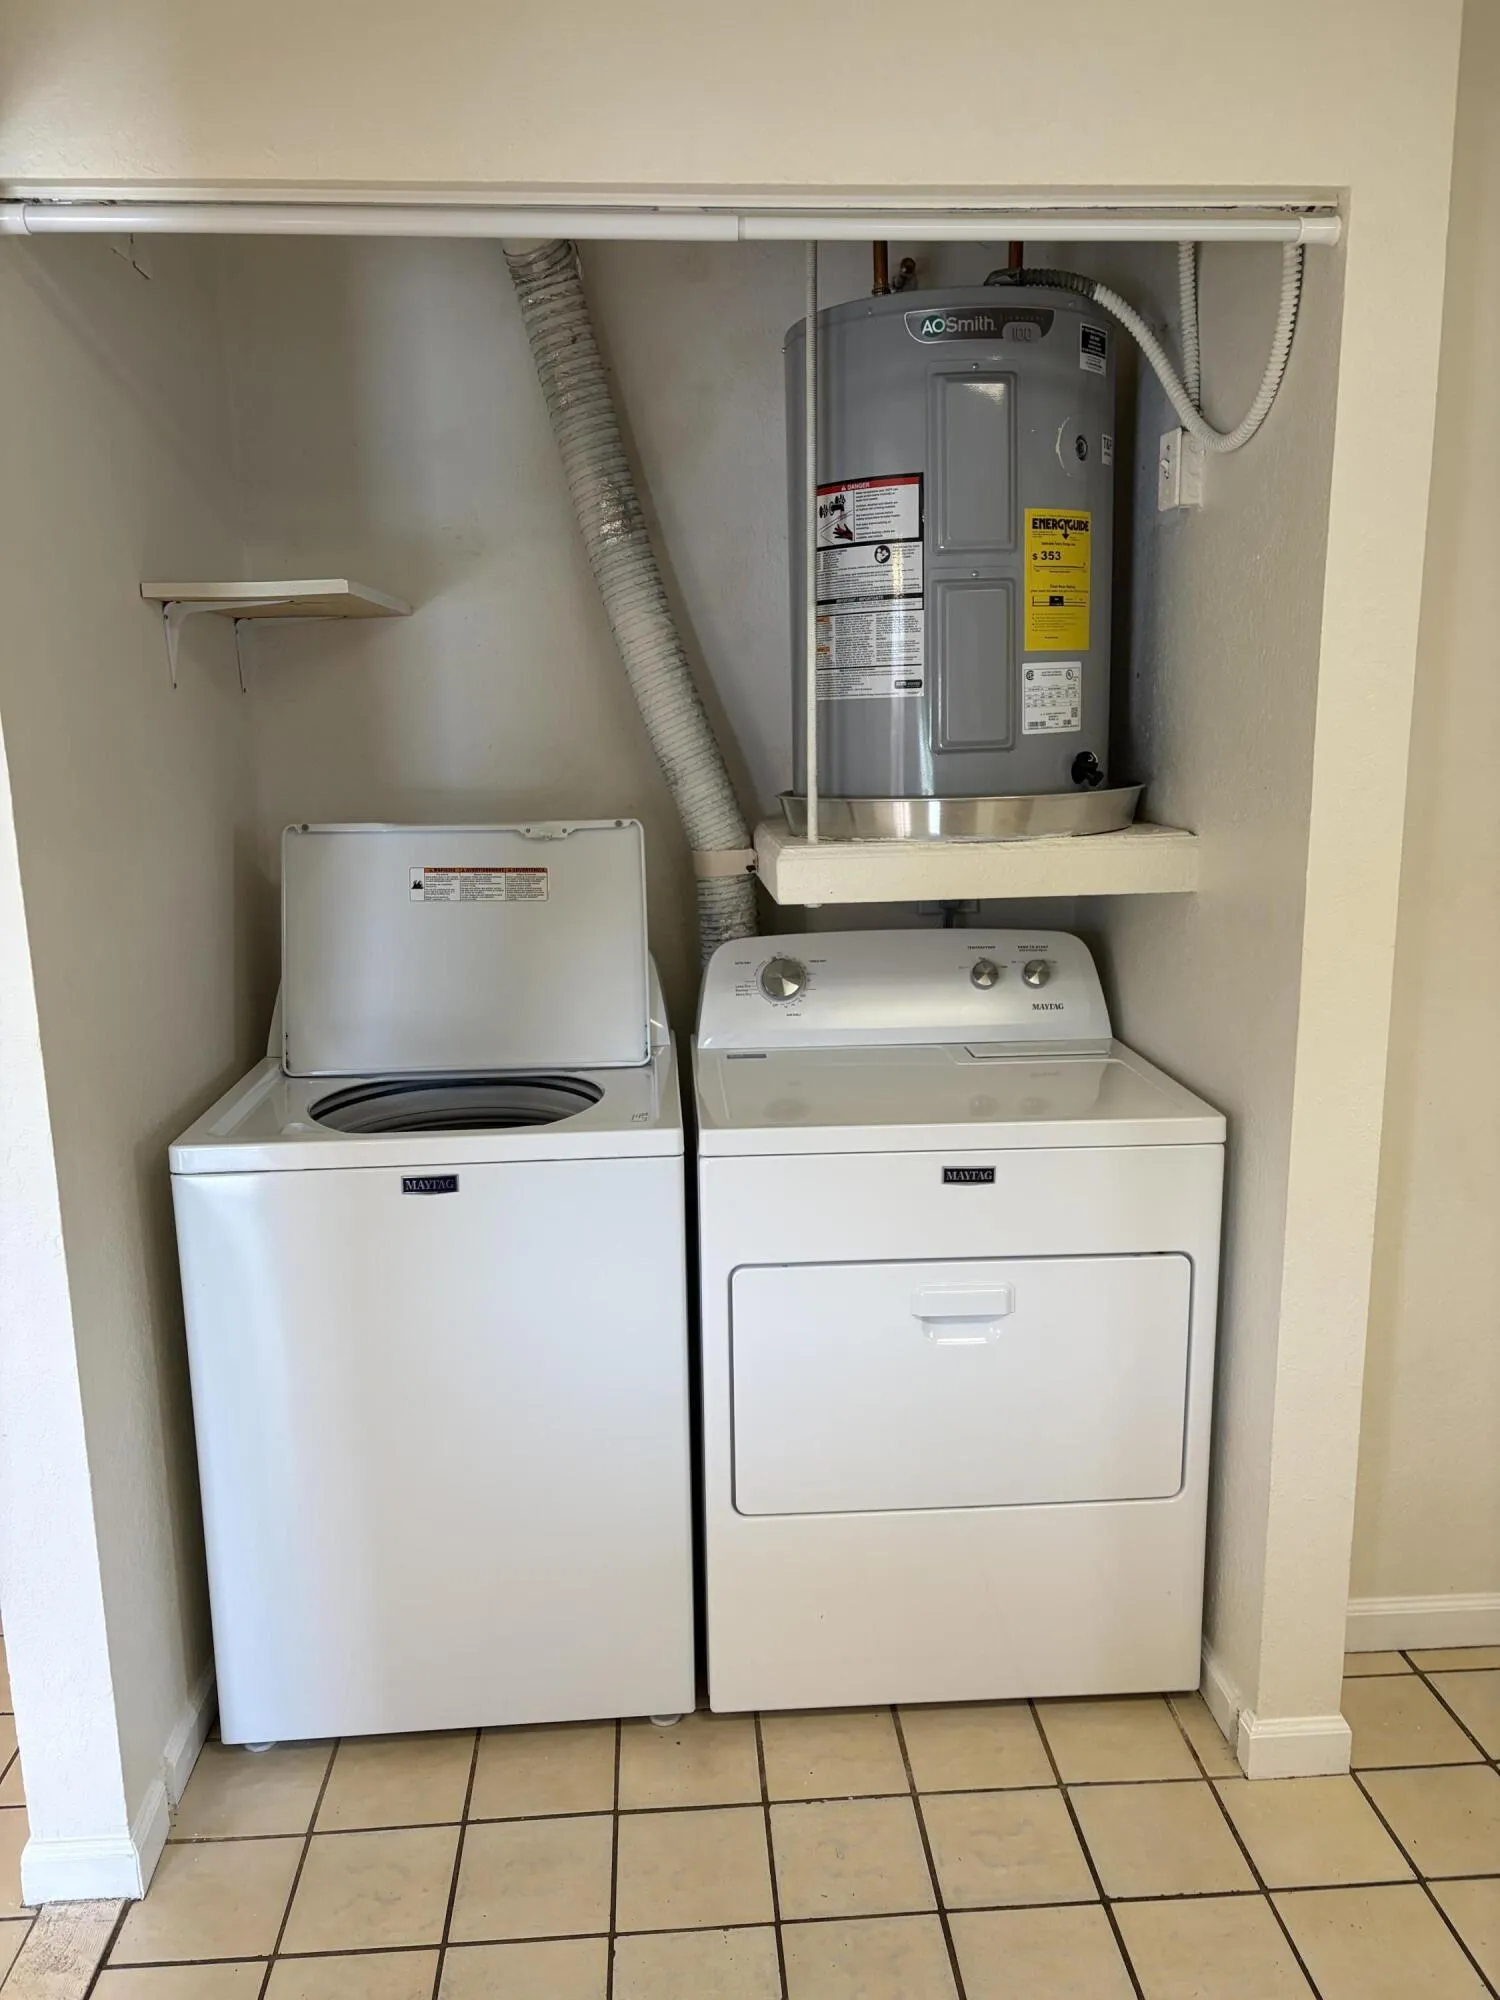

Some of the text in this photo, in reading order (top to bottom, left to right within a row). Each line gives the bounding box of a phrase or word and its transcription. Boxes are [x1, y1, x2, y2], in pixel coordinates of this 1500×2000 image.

[847, 481, 870, 491] DANGER
[1041, 550, 1061, 561] 353
[1032, 1003, 1064, 1011] MAYTAG
[946, 1170, 993, 1181] MAYTAG
[405, 1179, 455, 1190] MAYTAG
